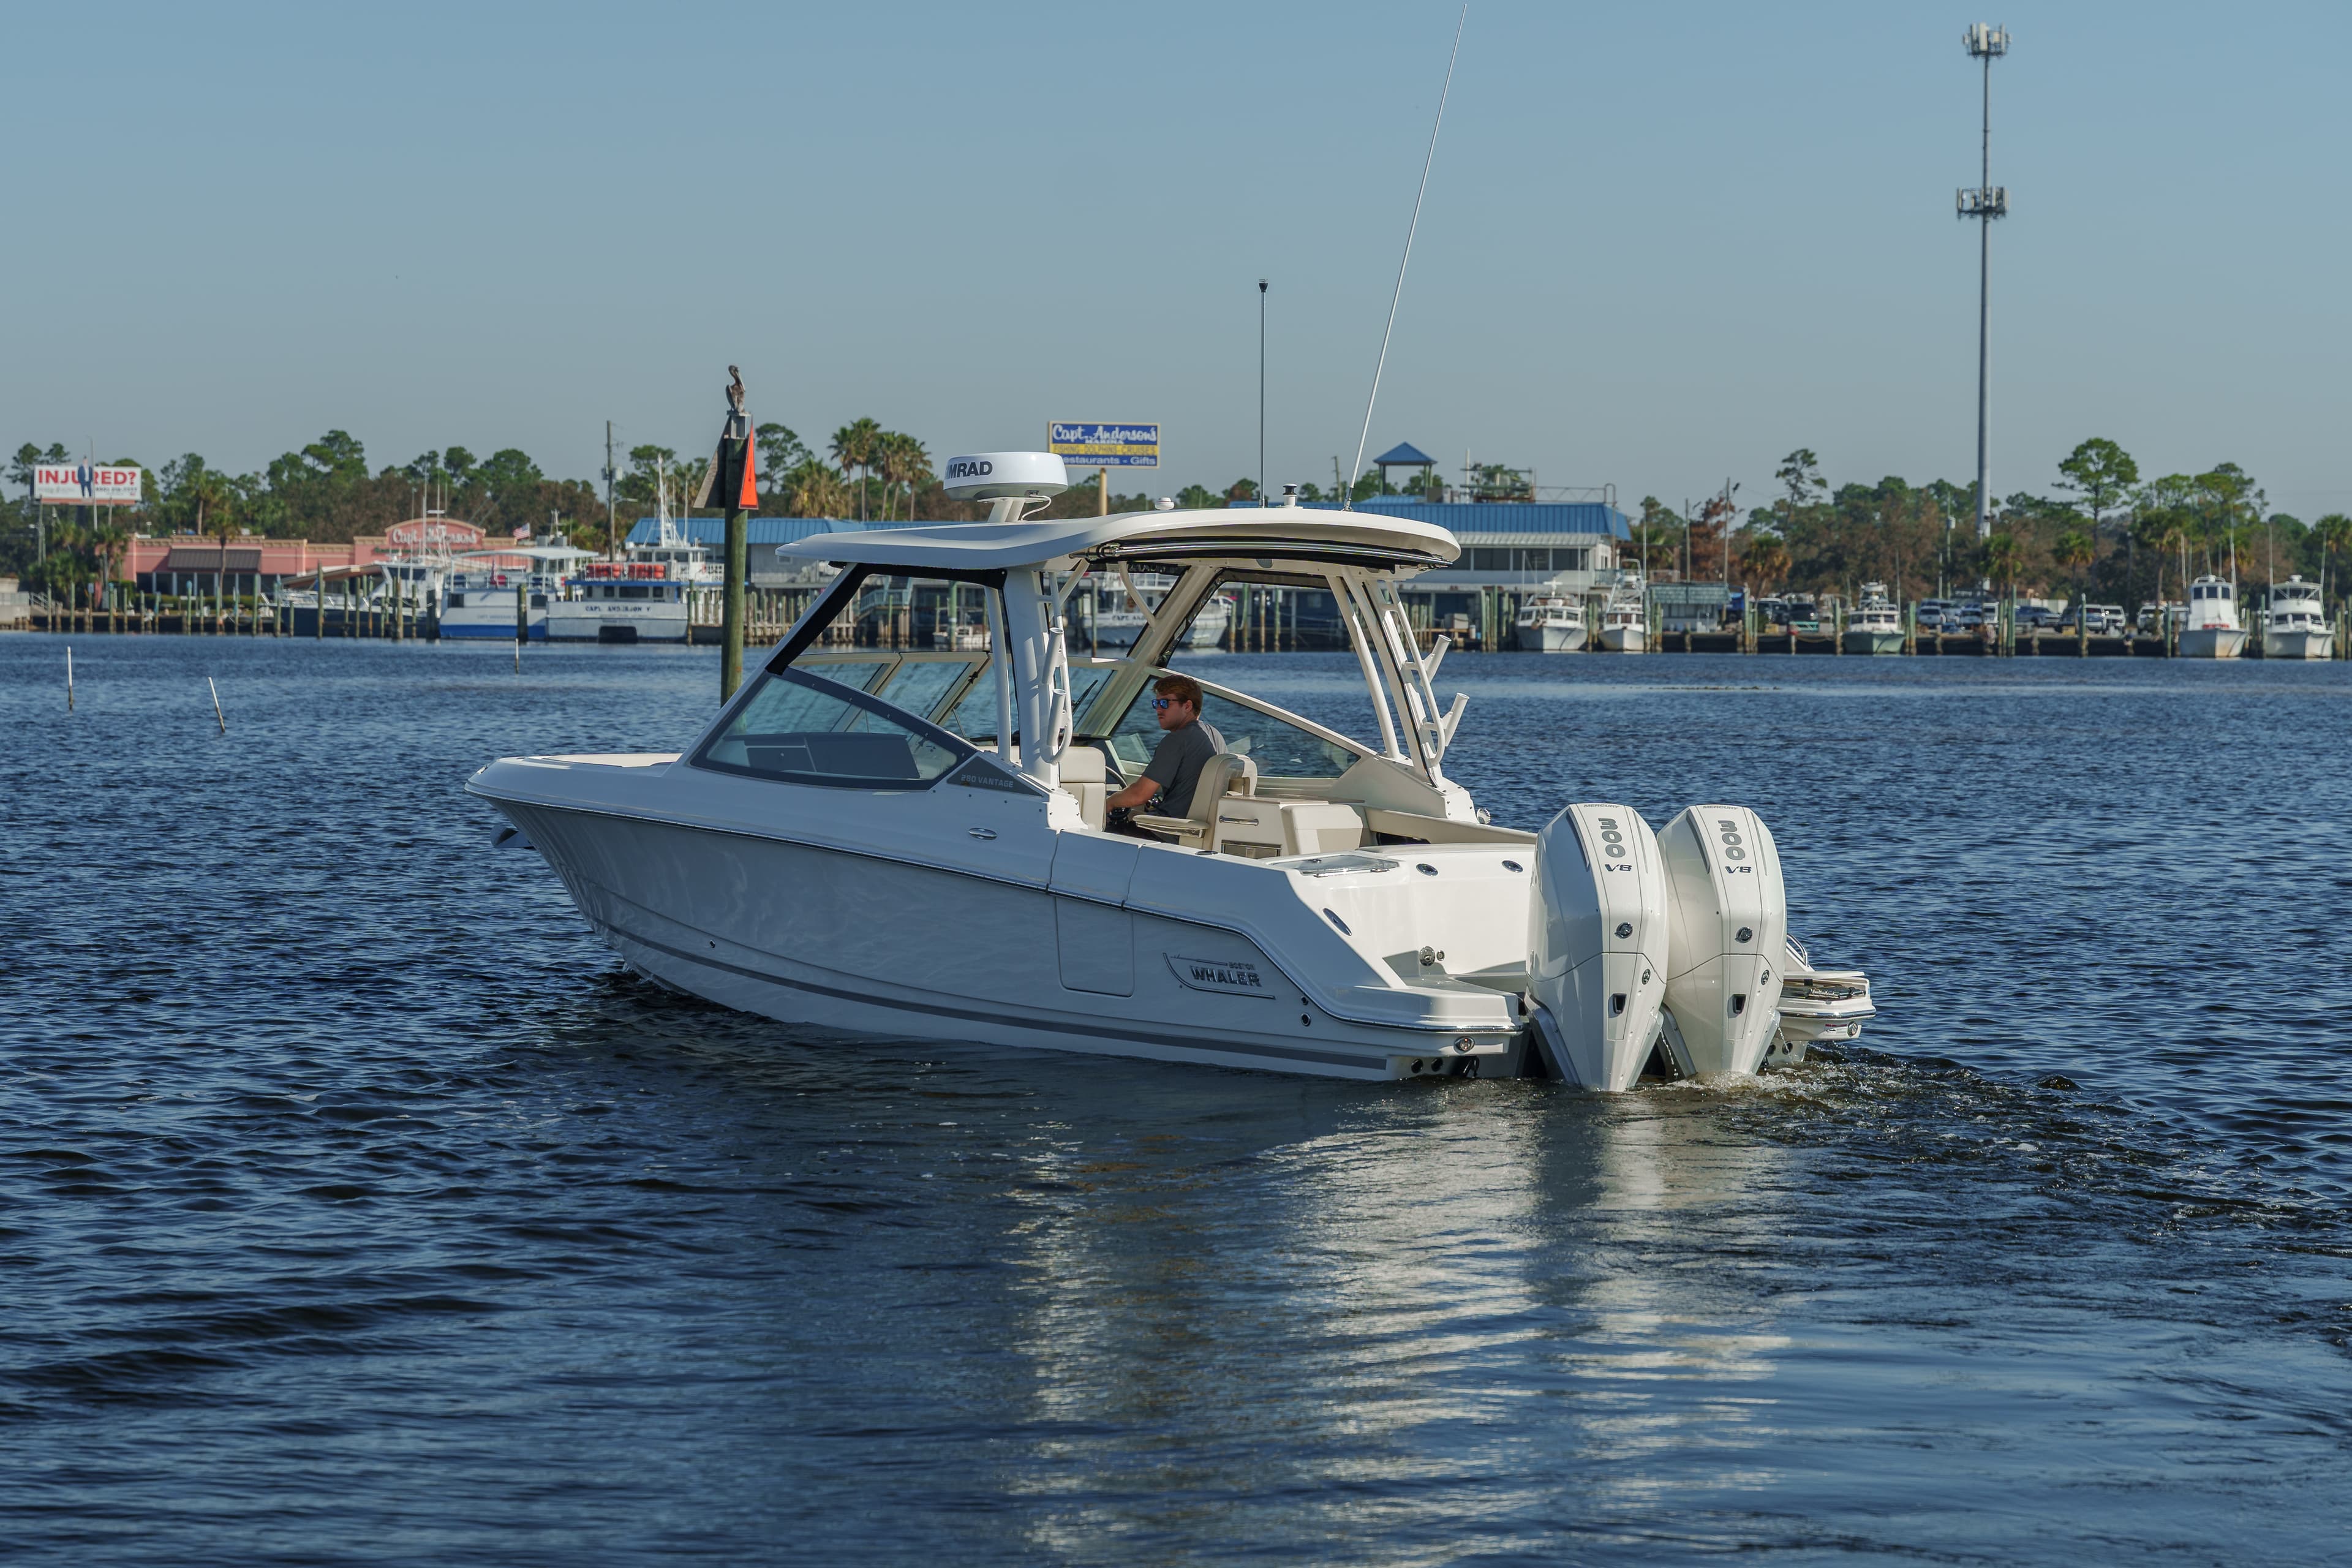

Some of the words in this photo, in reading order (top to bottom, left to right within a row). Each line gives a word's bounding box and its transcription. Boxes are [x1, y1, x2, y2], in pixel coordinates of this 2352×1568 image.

[945, 461, 993, 479] IMRAD
[1063, 456, 1120, 464] estaurants
[1129, 456, 1156, 466] Gifts
[960, 774, 976, 783] 280
[978, 775, 1014, 788] VANTAGE
[1598, 818, 1626, 858] 300
[1717, 820, 1746, 861] 300
[1228, 961, 1255, 970] BOSTON
[1189, 965, 1262, 987] WHALER
